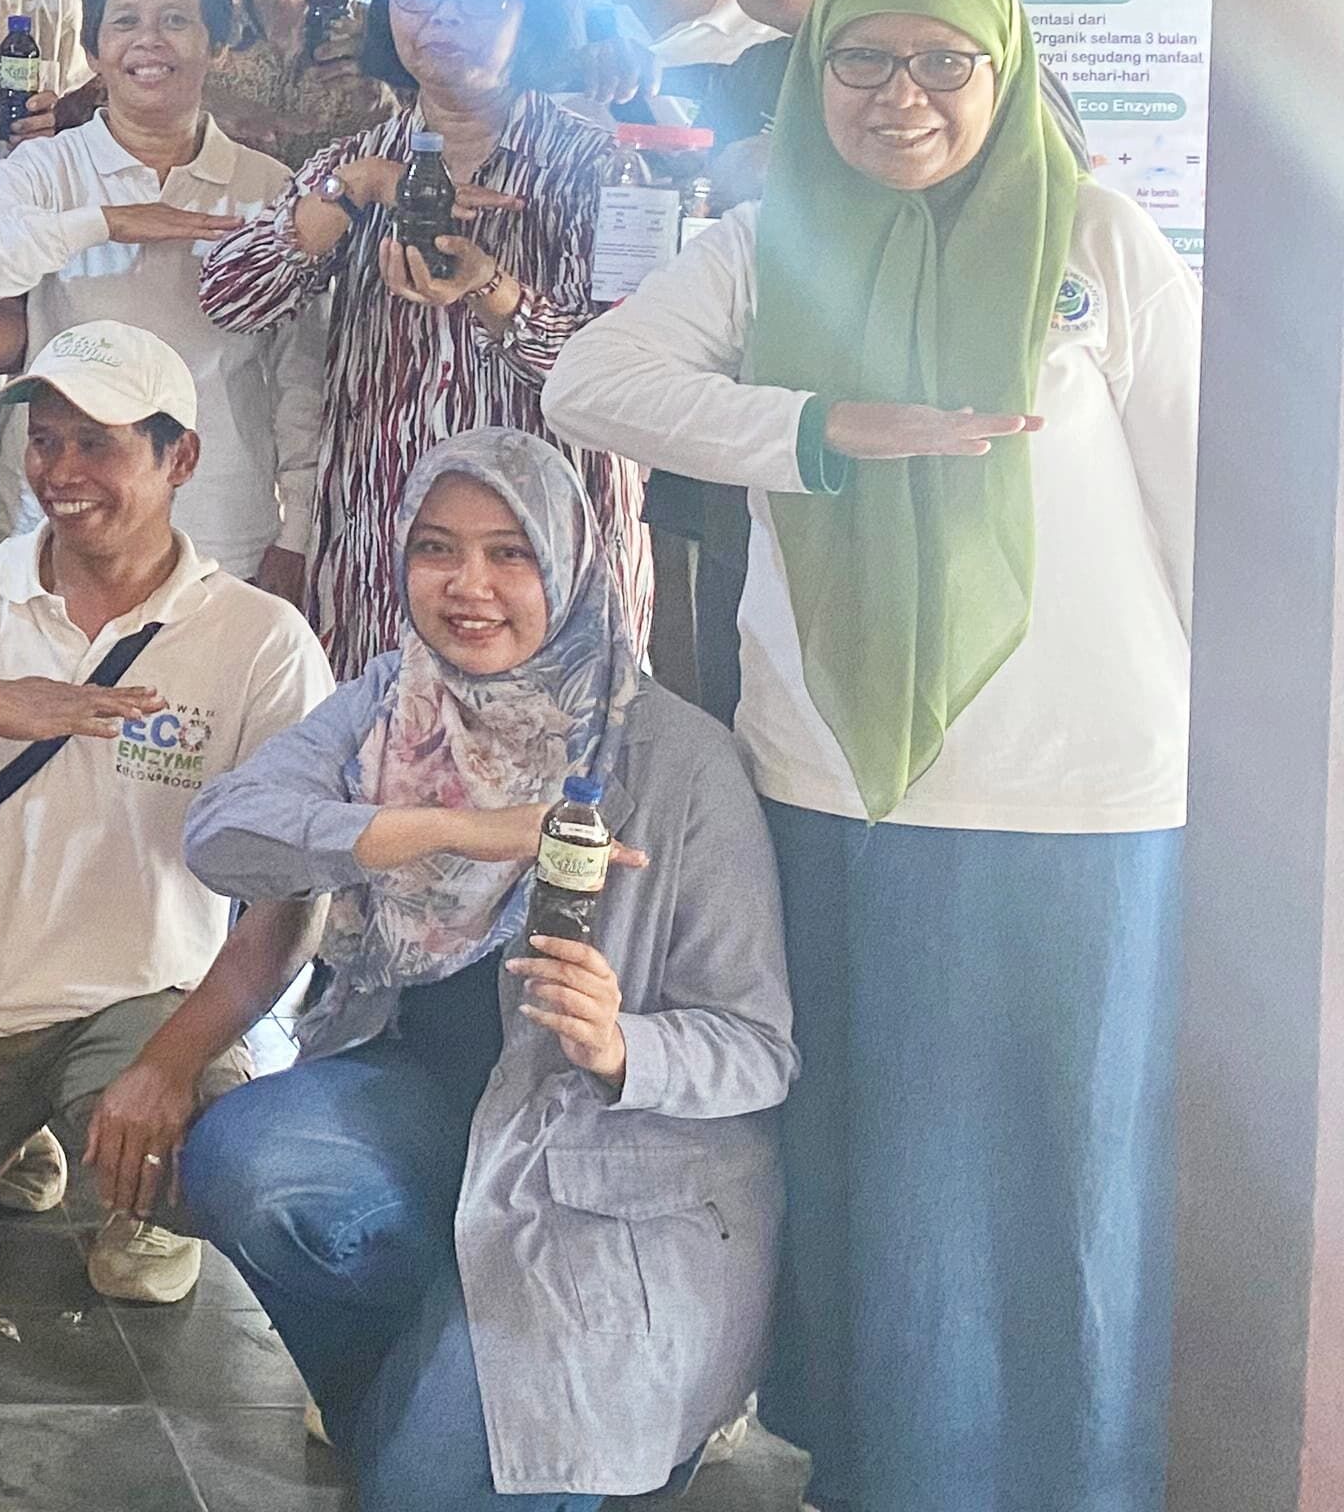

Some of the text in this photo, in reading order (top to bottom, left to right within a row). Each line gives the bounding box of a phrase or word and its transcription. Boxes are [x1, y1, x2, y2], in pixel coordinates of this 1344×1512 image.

[1031, 13, 1106, 26] entasi dari
[1090, 32, 1142, 45] selama
[1145, 32, 1154, 45] 3
[1158, 32, 1198, 45] bulan
[1039, 51, 1204, 66] nyai segudang manfaat
[1072, 70, 1151, 82] sehari-hari
[1077, 98, 1179, 116] Eco Enzyme
[117, 740, 204, 771] ENZYME
